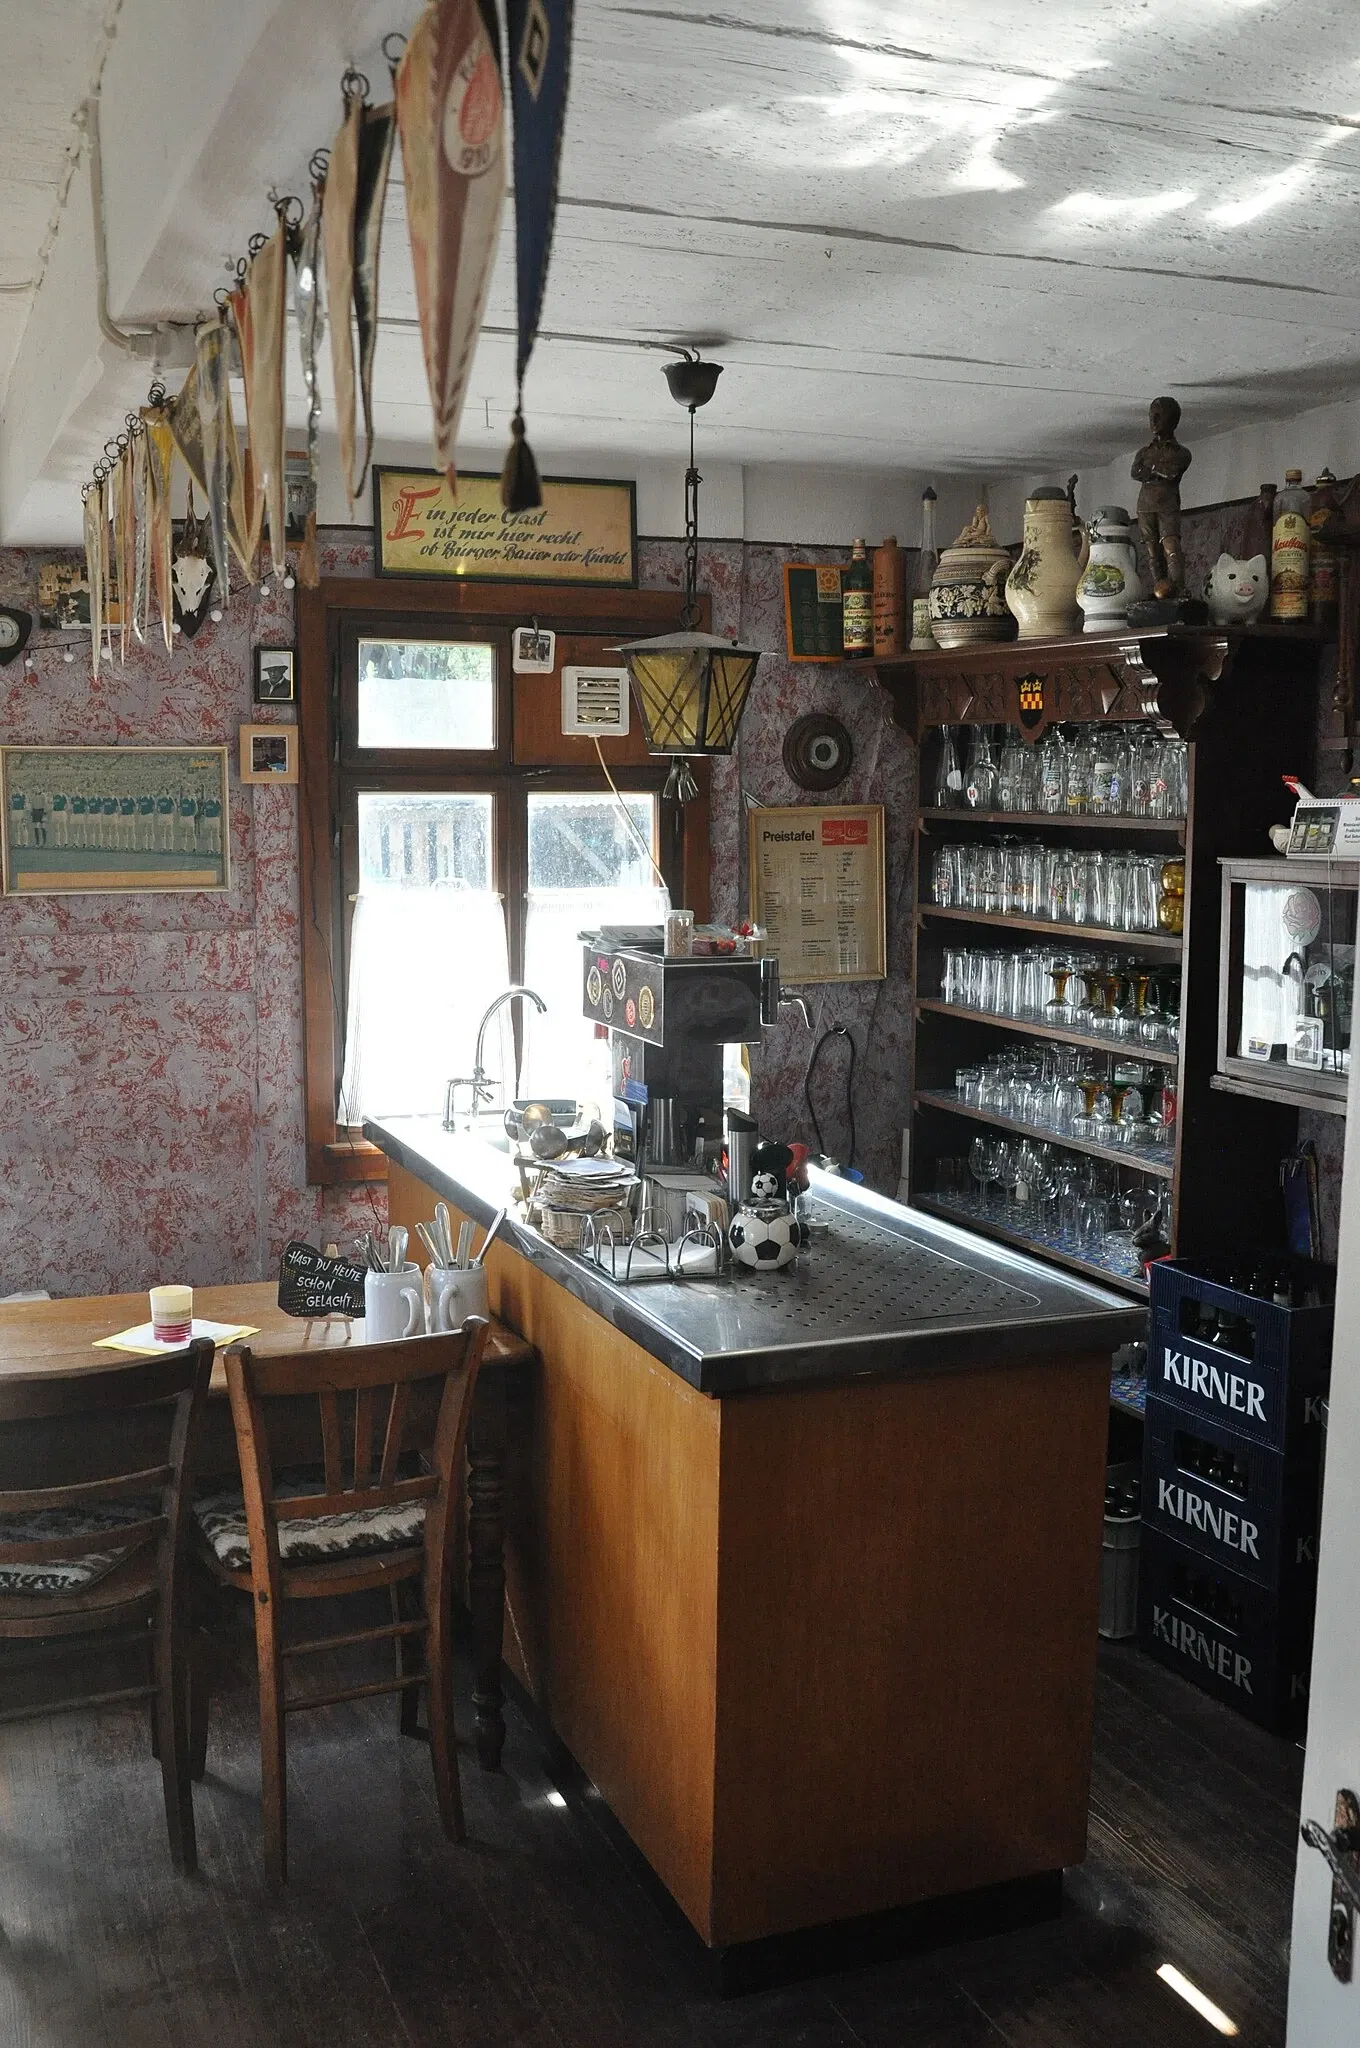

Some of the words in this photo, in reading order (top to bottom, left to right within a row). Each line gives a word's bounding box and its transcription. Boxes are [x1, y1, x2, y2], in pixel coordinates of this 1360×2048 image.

[386, 485, 447, 543] Ein
[445, 502, 496, 525] jeder
[500, 507, 549, 527] Gast
[433, 522, 457, 539] ist
[458, 524, 495, 541] mir
[496, 524, 535, 543] hier
[420, 541, 439, 556] ob
[552, 550, 582, 562] oder
[763, 830, 815, 842] Preistafel
[288, 1251, 312, 1264] HAST
[315, 1258, 331, 1272] DU
[333, 1264, 362, 1281] HEUTE
[297, 1276, 335, 1291] SCHON
[306, 1293, 352, 1308] GELACHT
[1163, 1347, 1267, 1422] KIRNER
[1158, 1477, 1260, 1561] KIRNER
[1152, 1604, 1254, 1696] KIRNER
